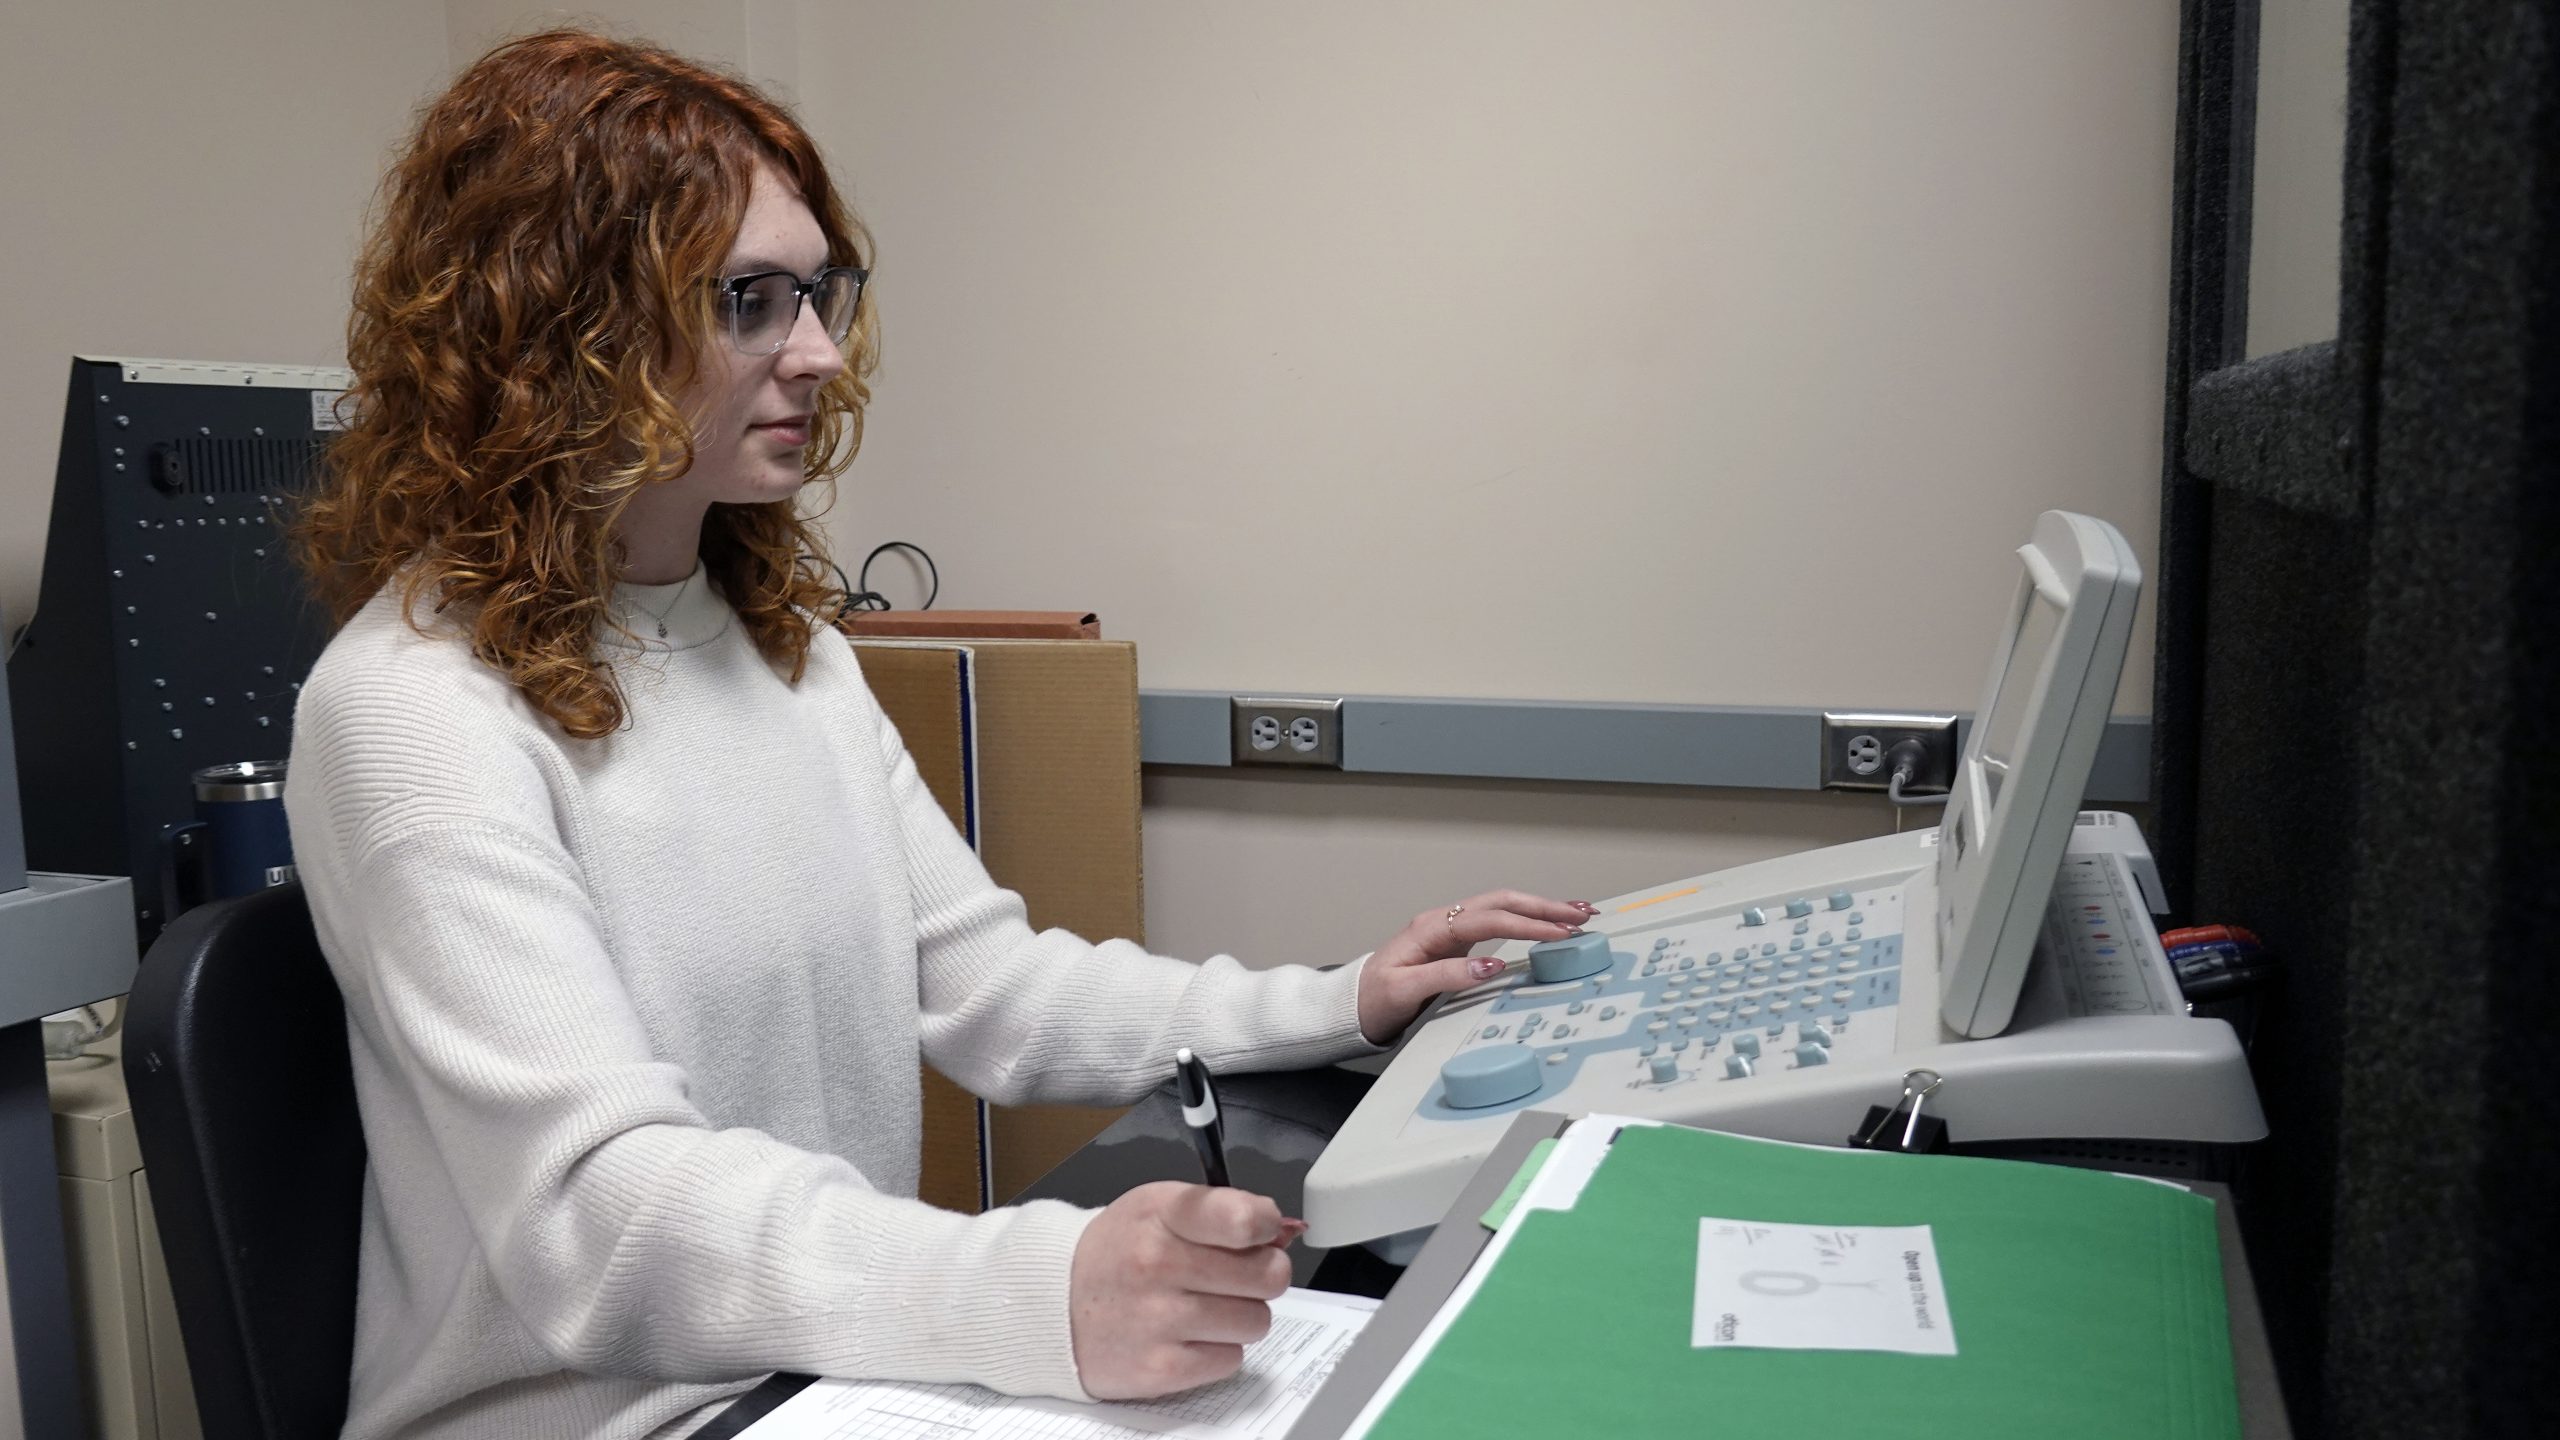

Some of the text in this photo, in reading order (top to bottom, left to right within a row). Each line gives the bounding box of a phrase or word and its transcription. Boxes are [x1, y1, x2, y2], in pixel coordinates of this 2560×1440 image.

[1901, 1250, 1935, 1329] Open up to the world
